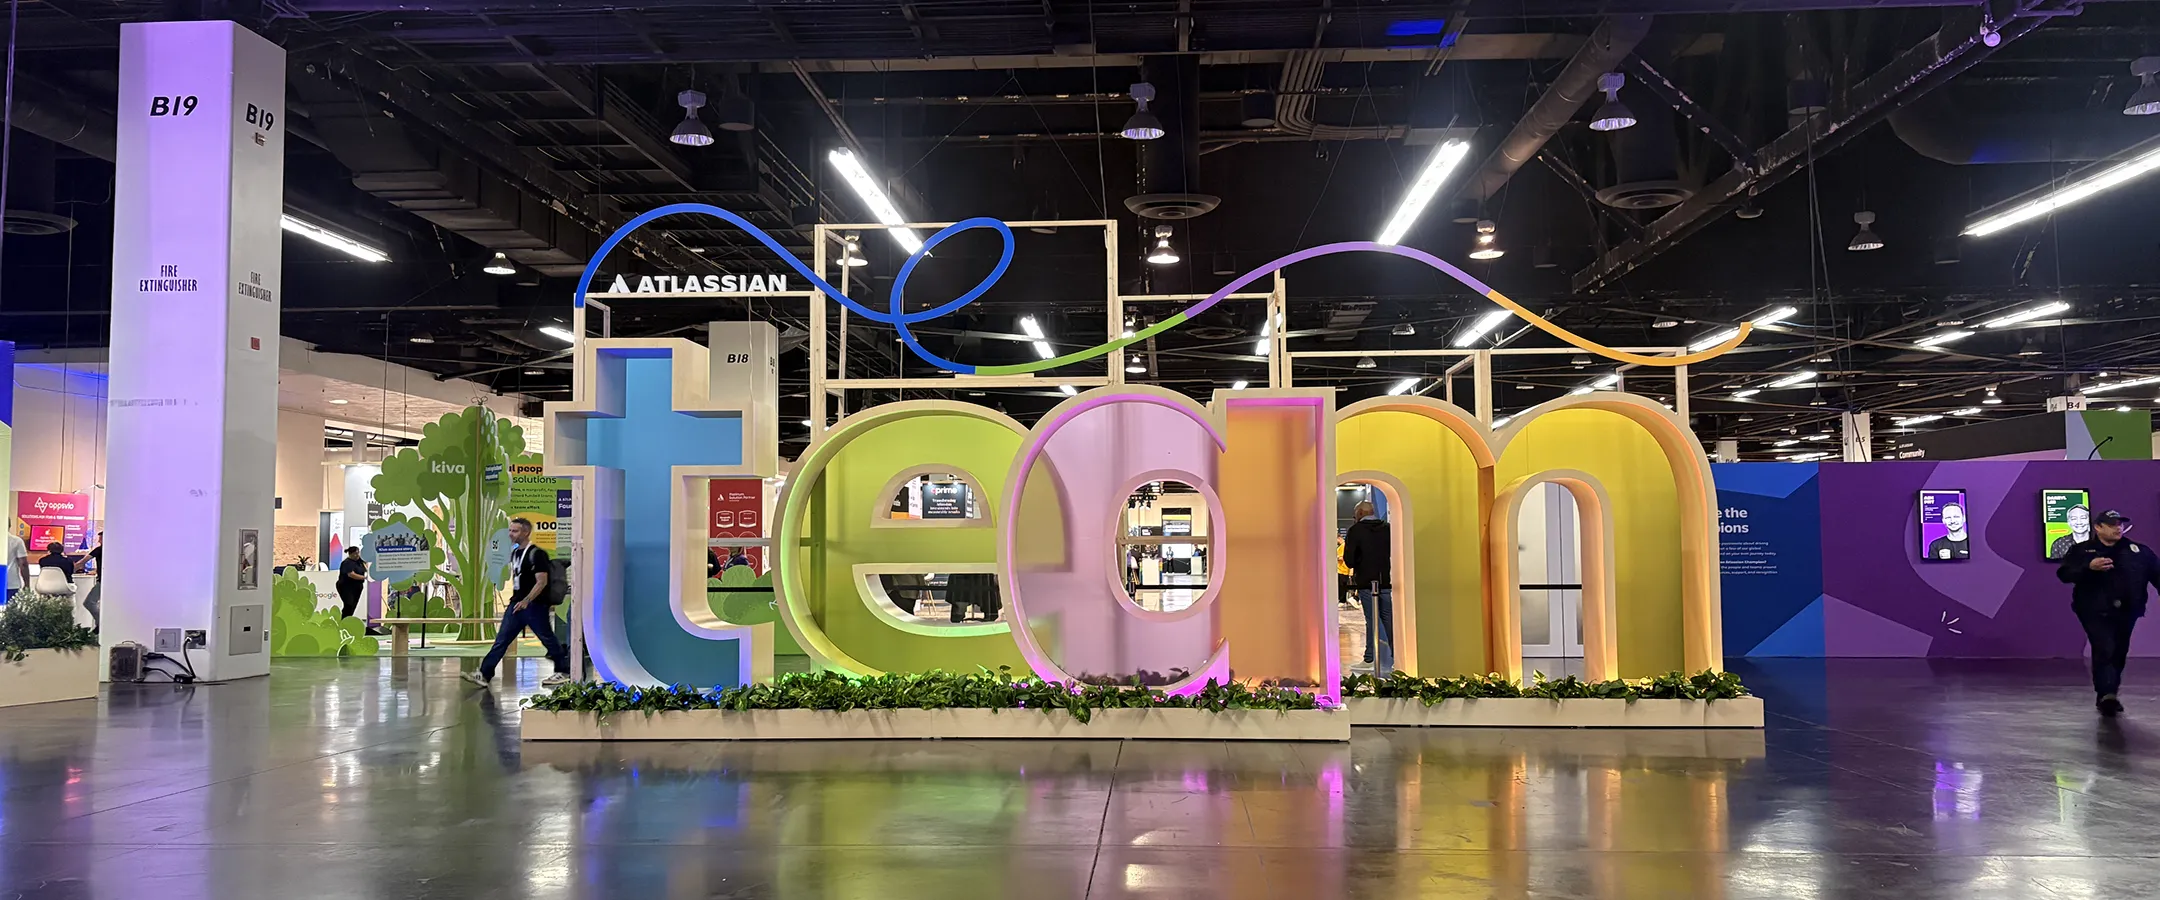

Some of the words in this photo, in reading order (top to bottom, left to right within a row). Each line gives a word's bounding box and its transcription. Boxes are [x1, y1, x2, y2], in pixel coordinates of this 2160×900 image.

[150, 96, 198, 116] B19
[246, 103, 274, 131] B19
[160, 265, 178, 278] FIRE
[250, 271, 261, 286] FIRE
[139, 279, 198, 292] EXTINGUISHER
[636, 274, 787, 293] ATLASSIAN
[238, 282, 272, 302] EXTINGUISHER
[727, 353, 749, 364] B18
[1899, 448, 1925, 459] Community
[431, 460, 465, 474] kiva
[512, 475, 557, 484] solutions
[1724, 507, 1748, 518] the
[544, 337, 1723, 705] team
